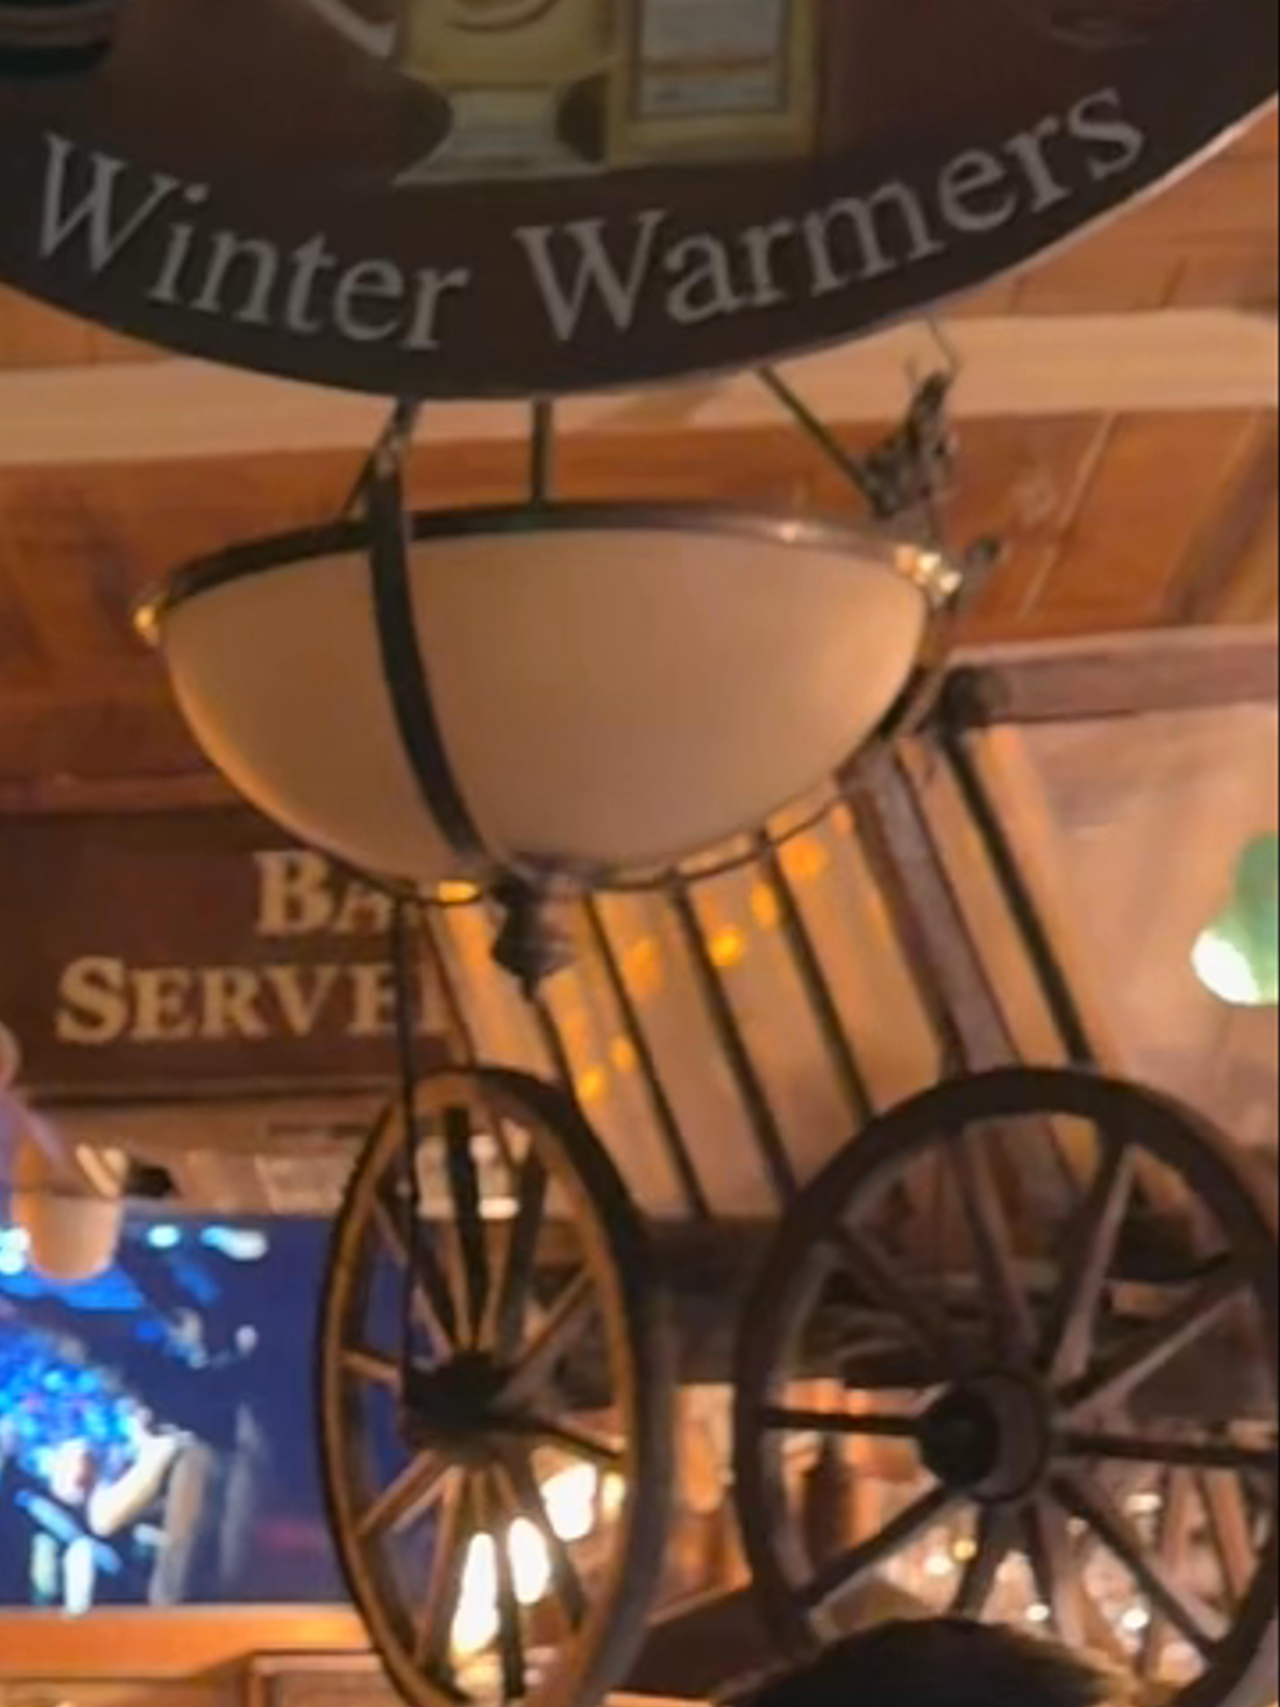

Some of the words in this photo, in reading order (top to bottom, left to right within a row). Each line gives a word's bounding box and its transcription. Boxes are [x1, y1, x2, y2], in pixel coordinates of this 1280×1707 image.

[38, 132, 469, 352] Winter
[514, 85, 1148, 343] Warmers
[252, 850, 415, 937] BA
